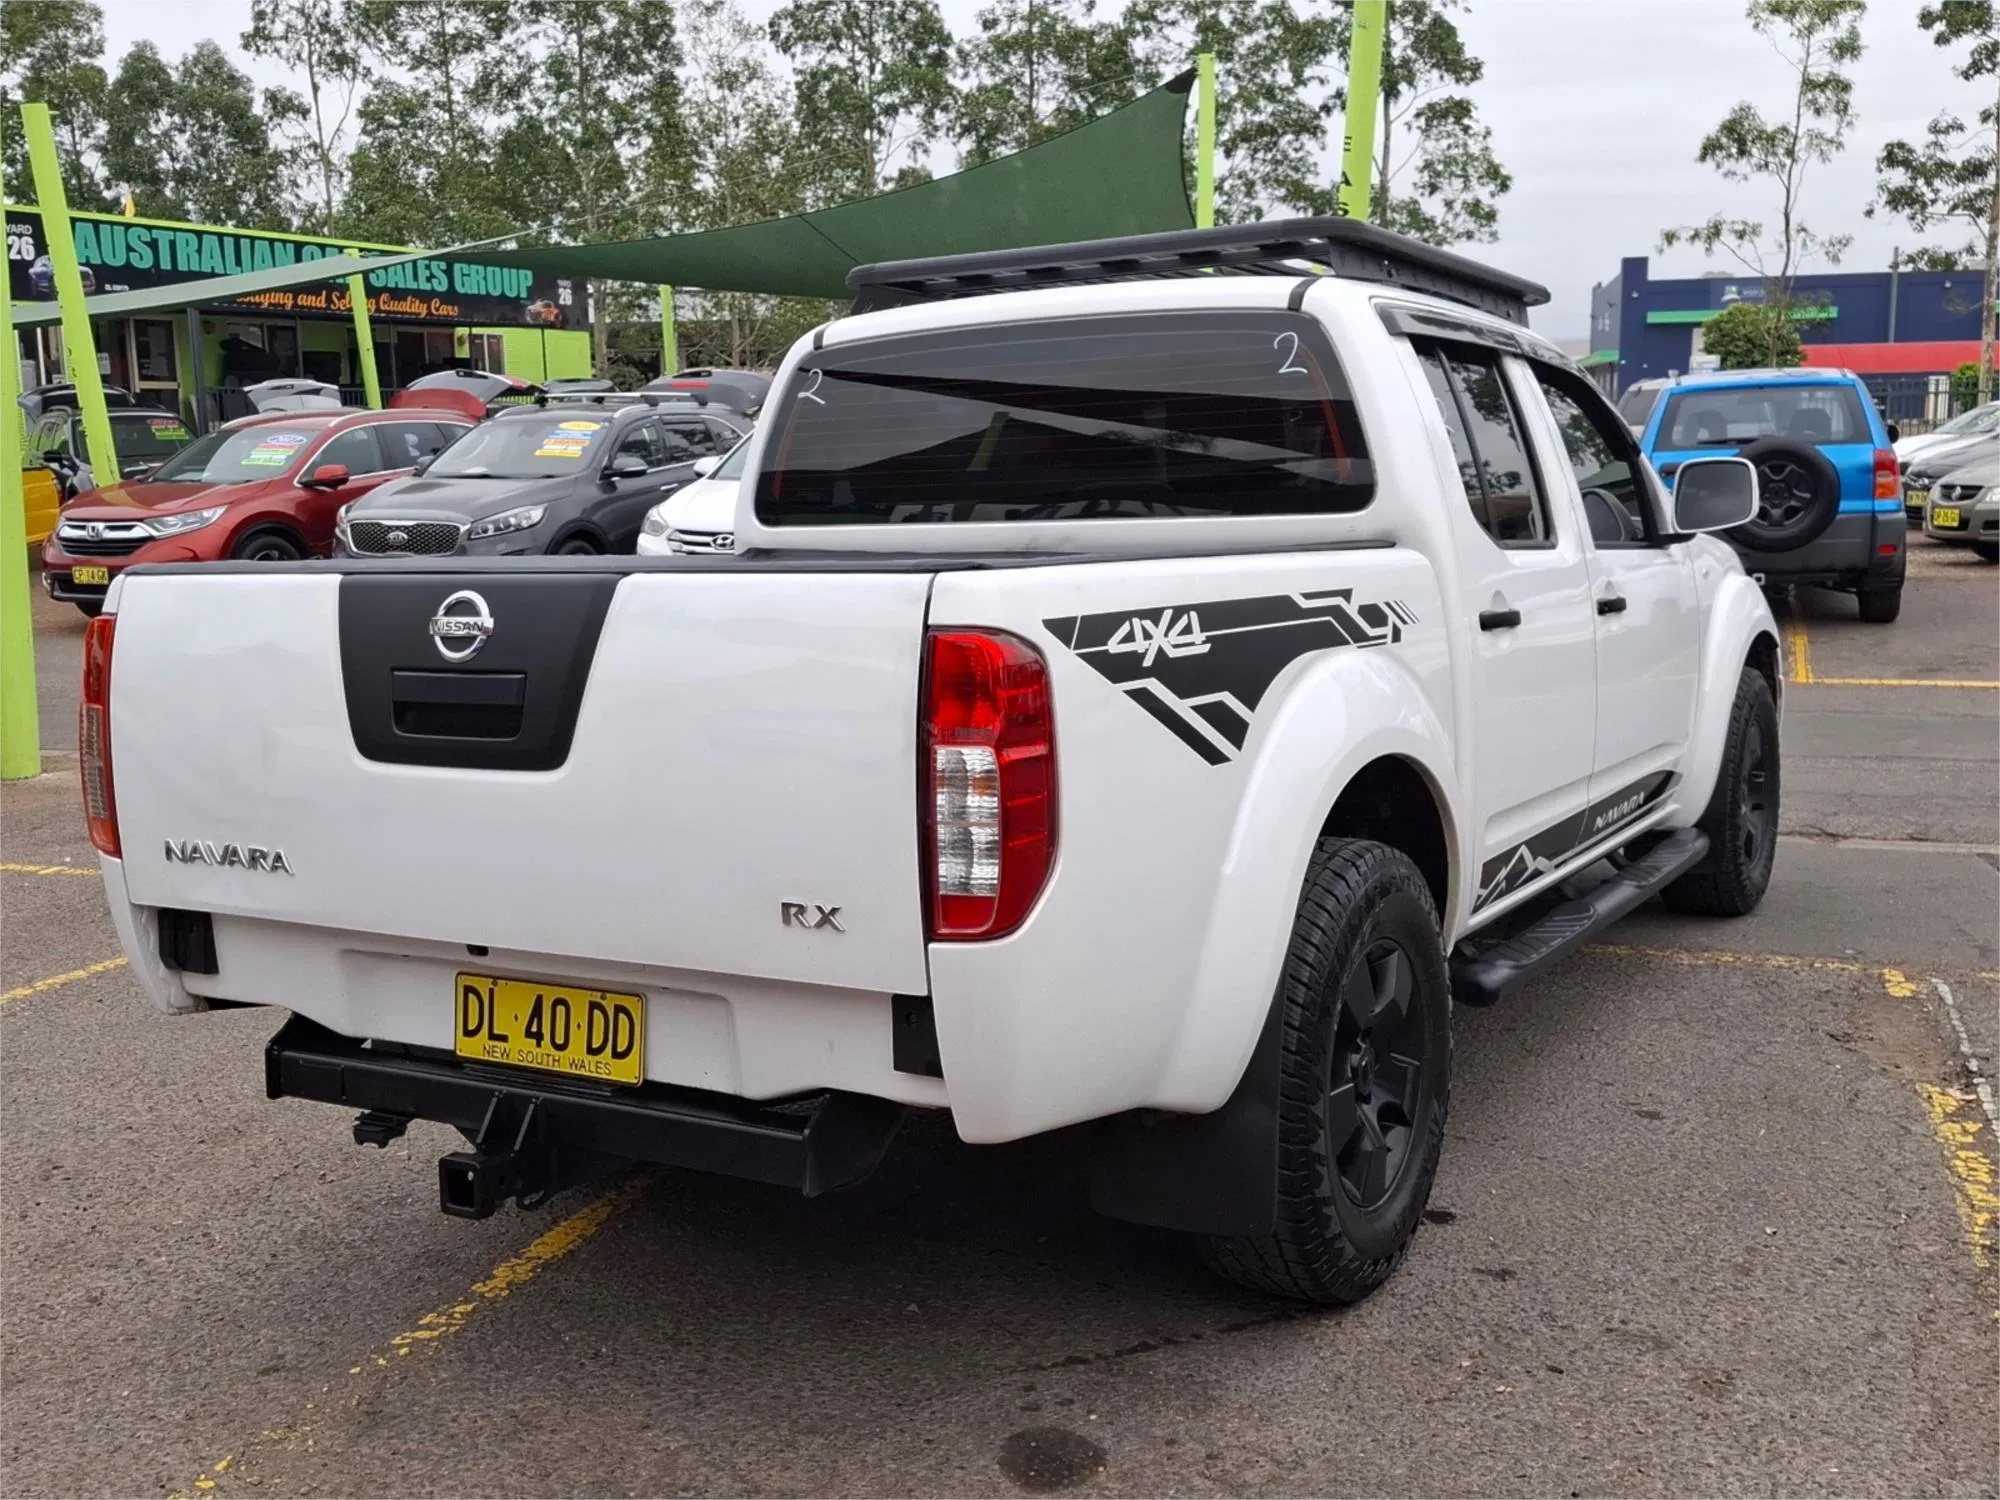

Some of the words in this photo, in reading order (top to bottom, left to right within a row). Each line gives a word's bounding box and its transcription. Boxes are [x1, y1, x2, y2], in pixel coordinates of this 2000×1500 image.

[6, 224, 33, 235] YARD
[7, 235, 36, 261] 26
[74, 221, 295, 276] AUSTRALIAN
[368, 255, 449, 292] SALES
[453, 262, 533, 299] GROUP
[297, 290, 327, 309] and
[379, 292, 428, 319] Quality
[431, 298, 459, 317] Cars
[558, 288, 573, 306] 26
[1273, 331, 1308, 374] 2
[797, 368, 826, 405] 2
[432, 620, 485, 633] NISSAN
[164, 838, 296, 877] NAVARA
[780, 900, 847, 932] RX
[462, 984, 509, 1043] DL
[524, 993, 571, 1052] 40
[586, 1000, 636, 1060] DD
[482, 1044, 511, 1060] NEW
[517, 1050, 561, 1068] SOUTH
[568, 1056, 613, 1076] WALES
